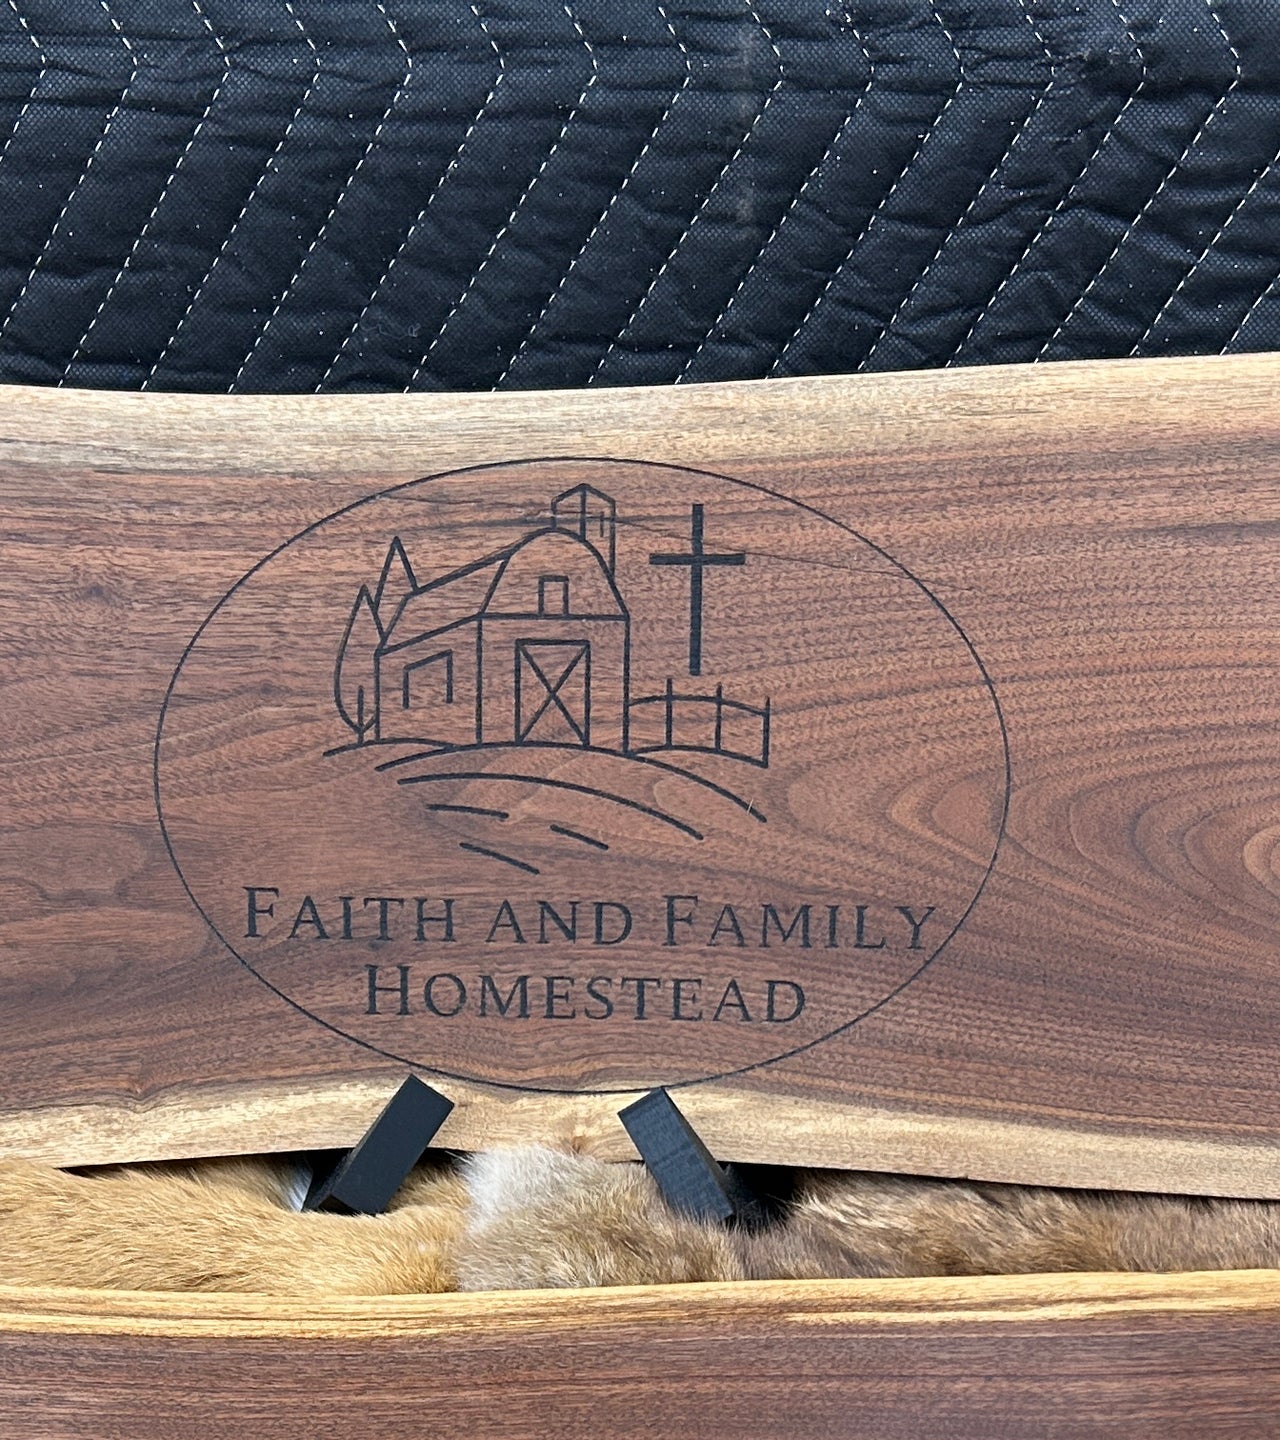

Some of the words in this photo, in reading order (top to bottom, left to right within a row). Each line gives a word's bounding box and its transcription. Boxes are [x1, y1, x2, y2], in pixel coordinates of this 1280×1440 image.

[242, 886, 457, 944] FAITH
[484, 899, 634, 946] AND
[663, 893, 937, 951] FAMILY
[363, 963, 807, 1024] HOMESTEAD
